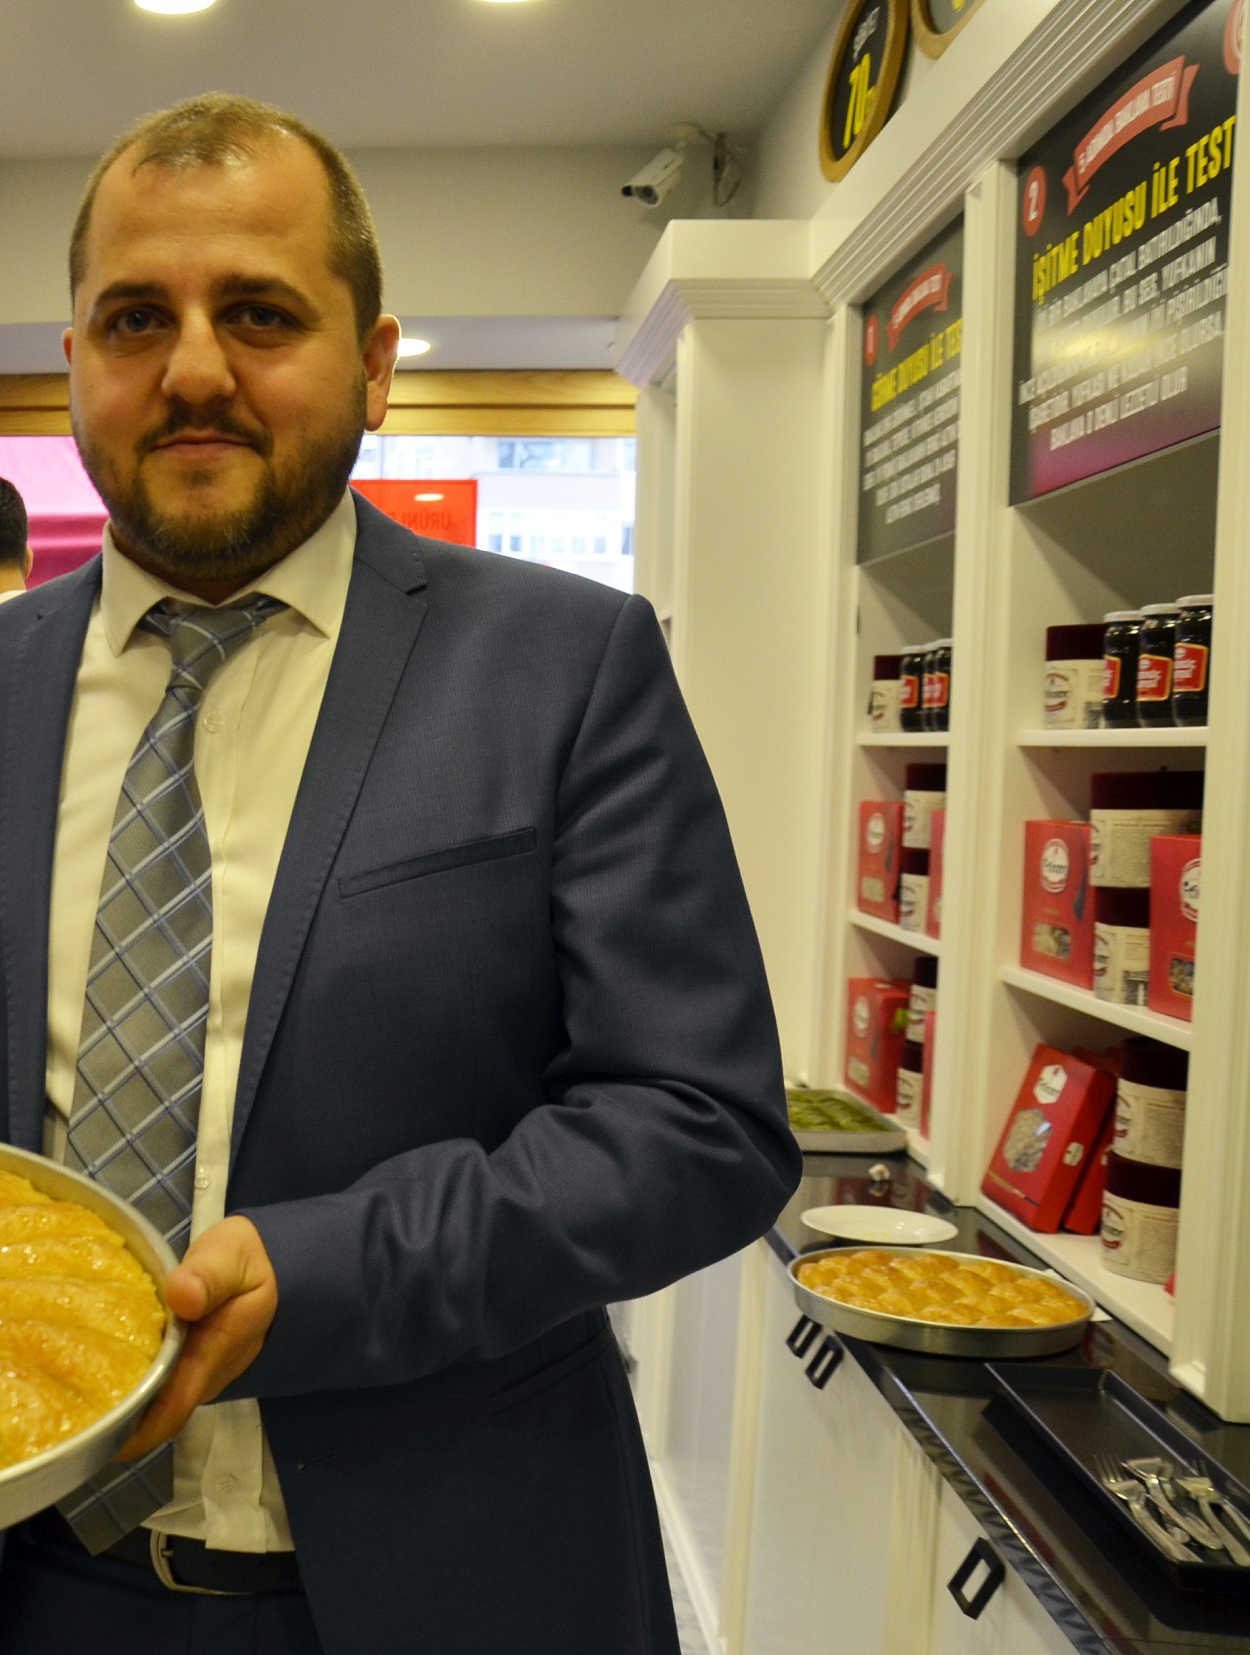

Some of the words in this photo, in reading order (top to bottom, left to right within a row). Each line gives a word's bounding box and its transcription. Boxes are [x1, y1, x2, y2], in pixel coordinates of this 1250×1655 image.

[1028, 180, 1039, 223] 2
[1032, 231, 1080, 306] İŞİTME
[1082, 180, 1148, 267] DUYUSU
[1150, 161, 1181, 219] İLE
[1185, 115, 1237, 195] TEST
[945, 318, 963, 360] TES
